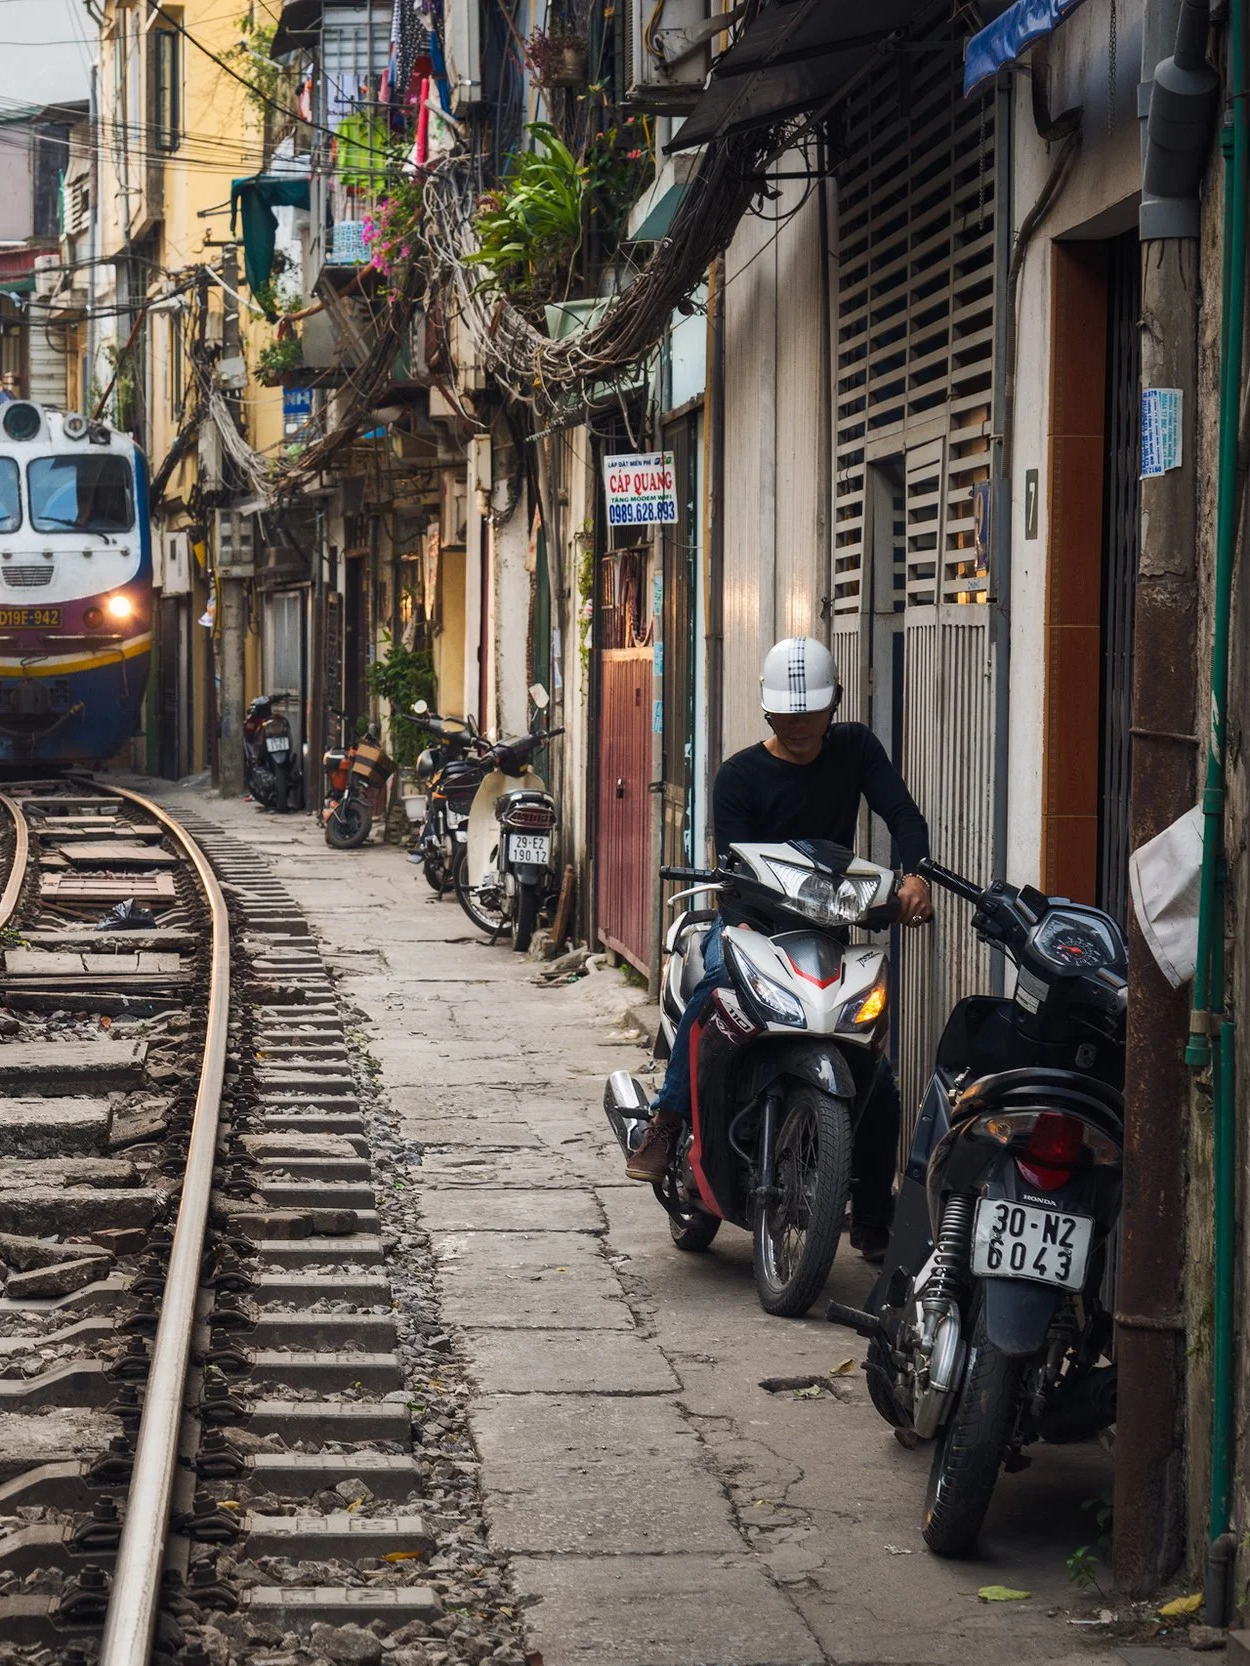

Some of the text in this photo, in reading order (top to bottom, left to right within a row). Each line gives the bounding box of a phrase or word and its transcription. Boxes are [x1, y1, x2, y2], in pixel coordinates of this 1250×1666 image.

[609, 469, 673, 496] CÁP QUANG
[630, 495, 656, 503] MODEM
[609, 501, 675, 524] 0989.628.893
[517, 836, 544, 849] 29-E2
[514, 850, 547, 862] 190.12
[1023, 1193, 1057, 1207] HONDA
[993, 1204, 1075, 1248] 30-N2
[987, 1240, 1072, 1281] 6043
